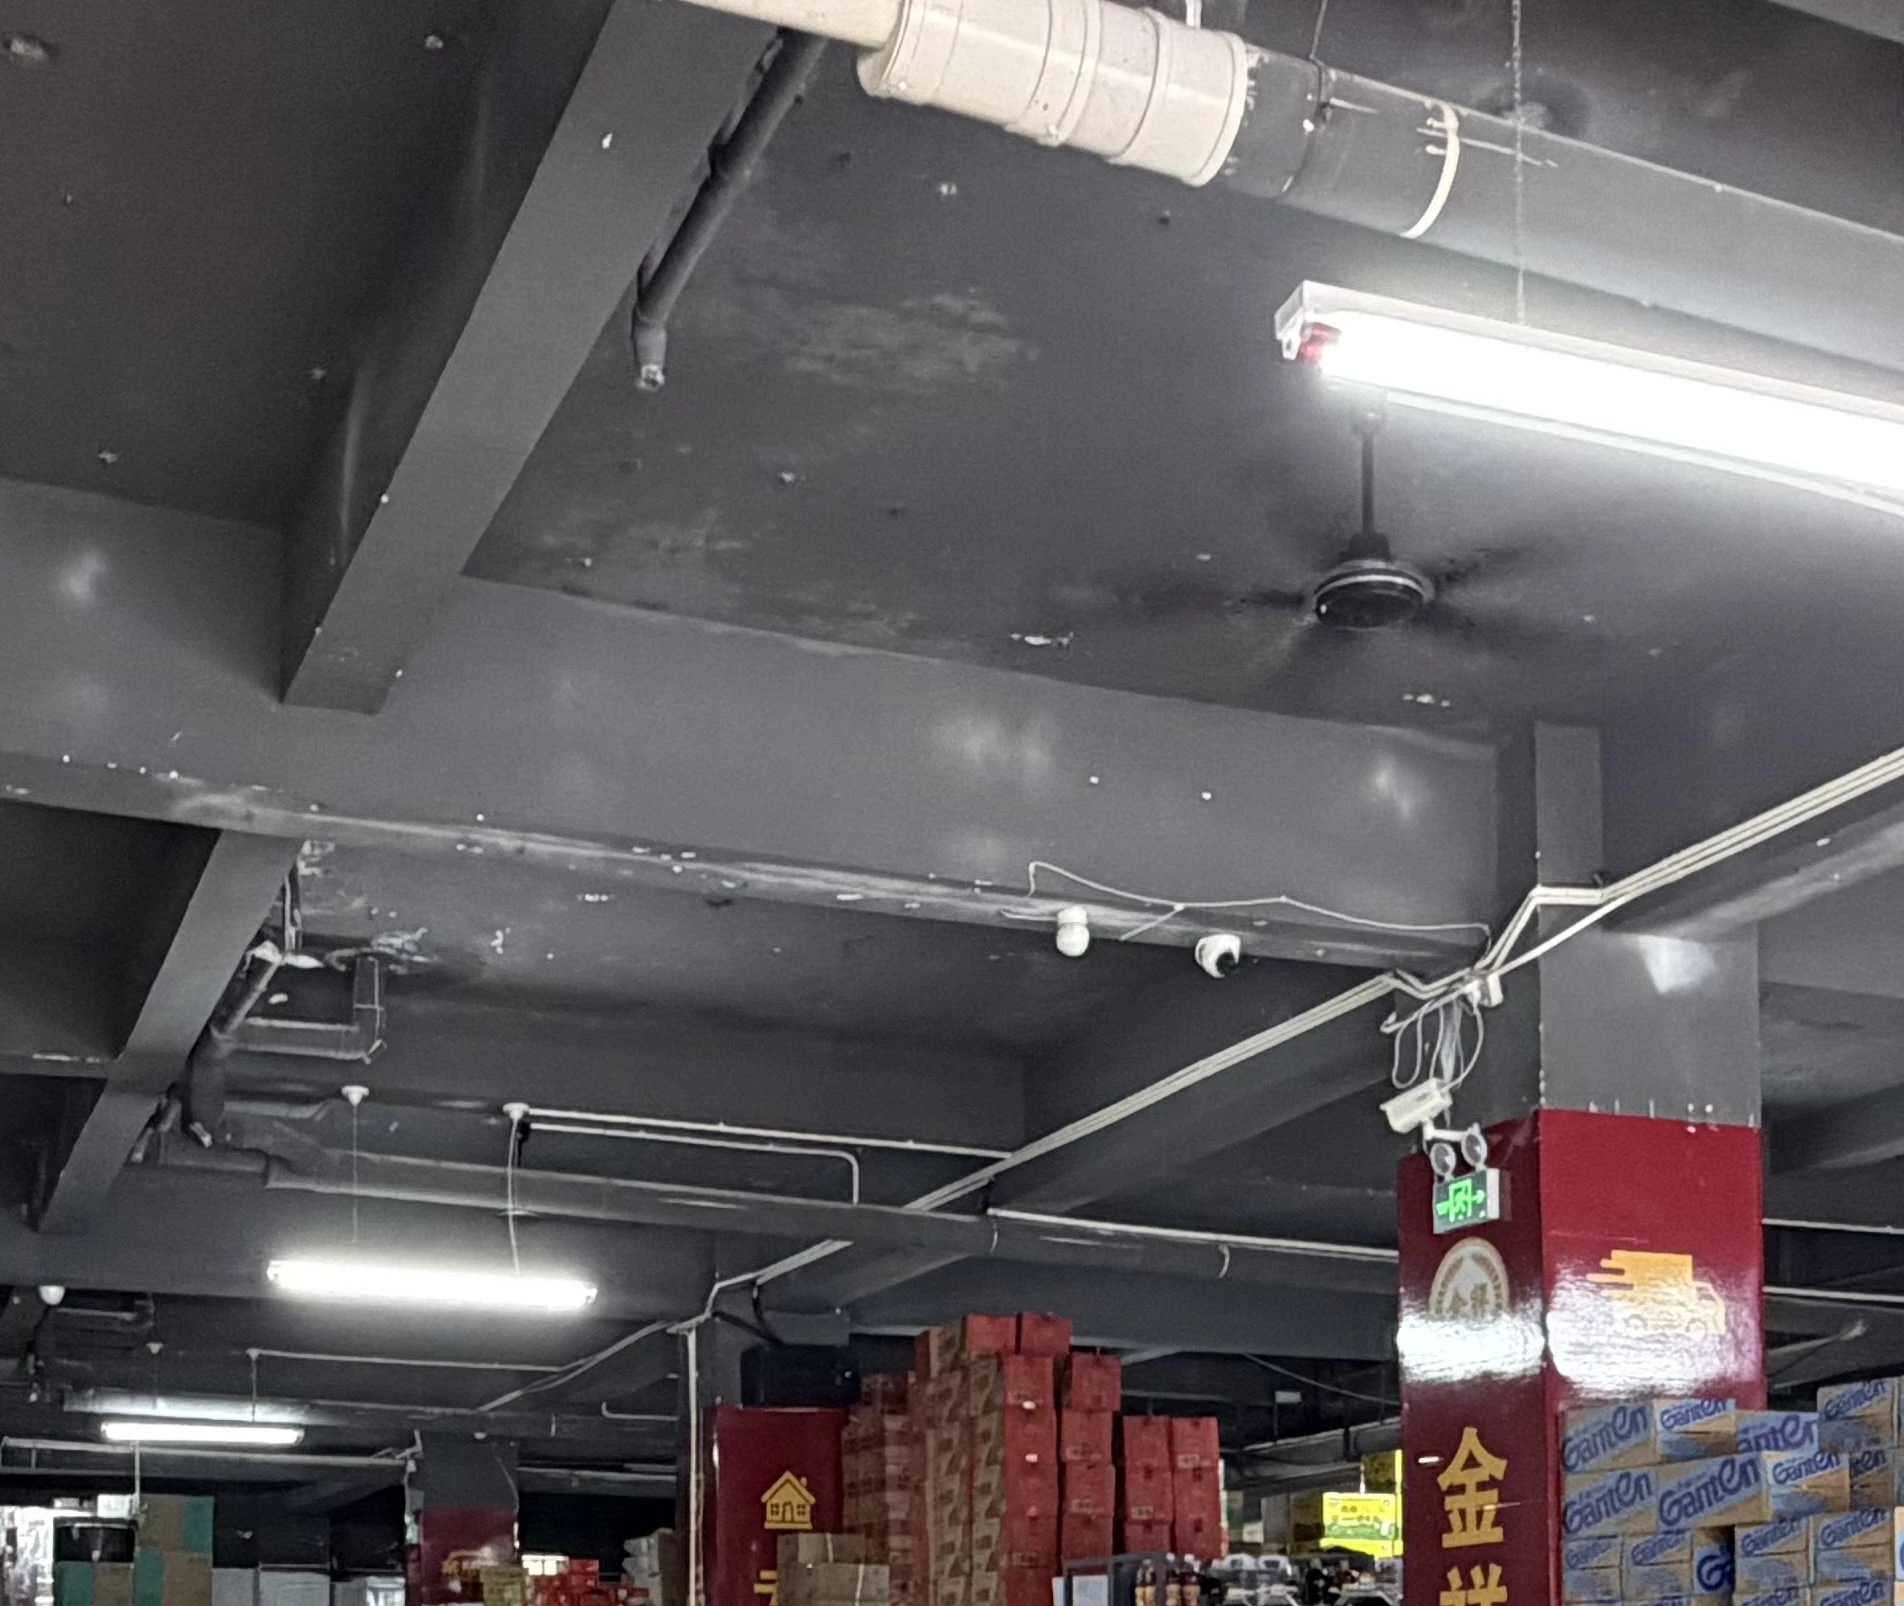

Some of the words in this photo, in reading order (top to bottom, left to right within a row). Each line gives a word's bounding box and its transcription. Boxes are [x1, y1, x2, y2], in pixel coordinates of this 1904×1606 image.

[1564, 1405, 1648, 1471] Ganten
[1737, 1414, 1815, 1453] anten
[1565, 1471, 1652, 1533] Ganten
[1659, 1458, 1757, 1525] Ganten
